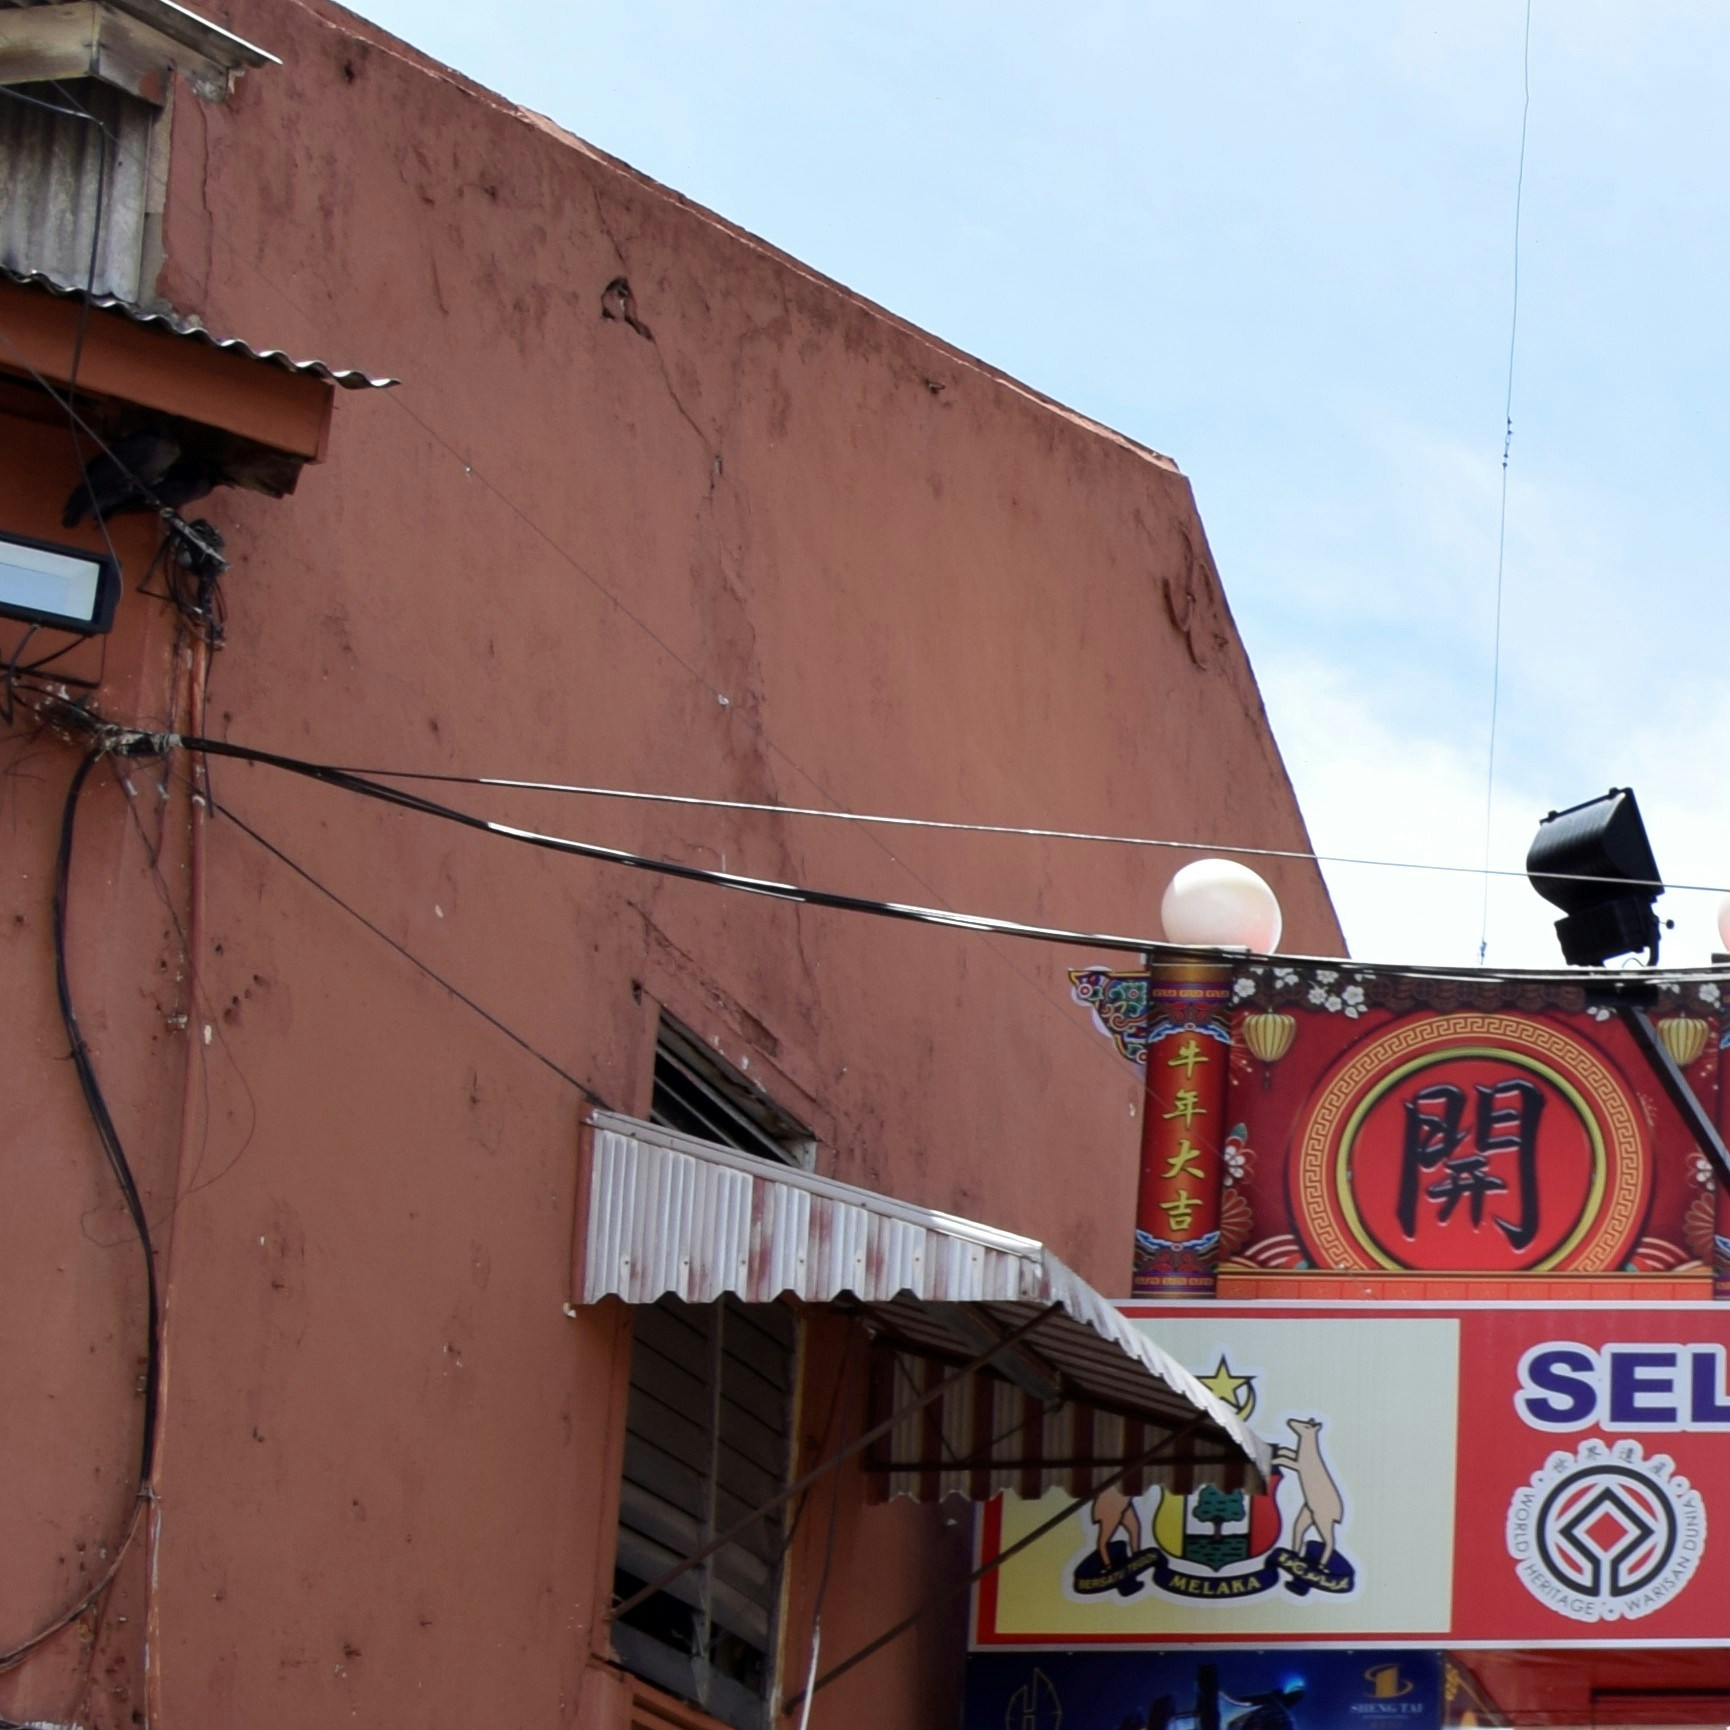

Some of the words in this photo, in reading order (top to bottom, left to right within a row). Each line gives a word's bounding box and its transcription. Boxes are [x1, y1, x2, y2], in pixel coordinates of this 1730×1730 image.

[1158, 1036, 1207, 1236] 牛年大吉
[1394, 1076, 1547, 1253] 開
[1168, 1574, 1262, 1596] MELAKA
[1512, 1492, 1535, 1554] WORLD
[1524, 1562, 1596, 1616] HERITAGE
[1624, 1556, 1691, 1612] WARISAN
[1683, 1497, 1700, 1552] DUNIA
